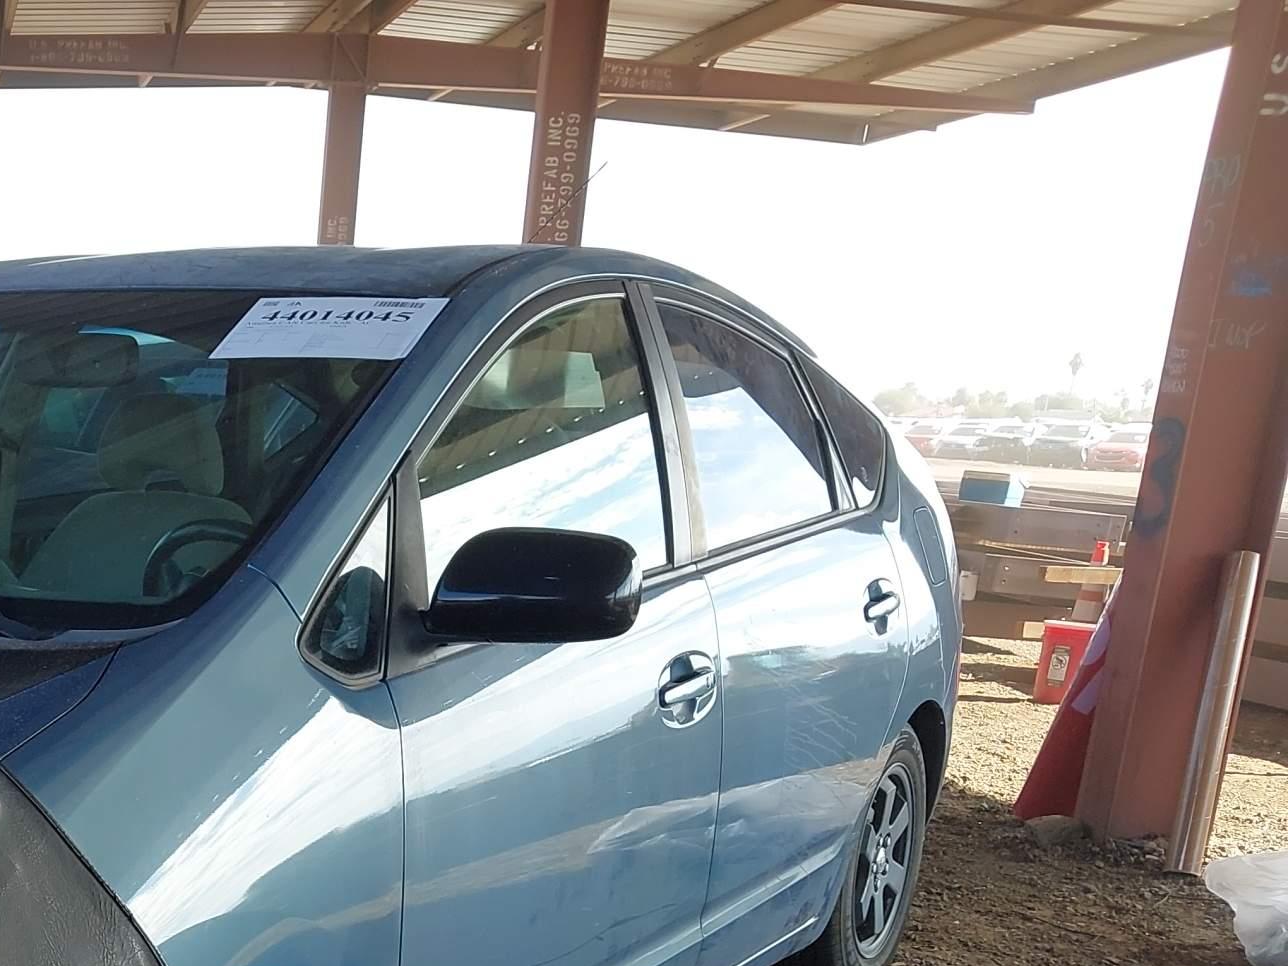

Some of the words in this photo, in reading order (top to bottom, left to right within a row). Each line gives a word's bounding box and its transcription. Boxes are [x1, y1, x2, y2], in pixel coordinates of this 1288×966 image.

[547, 111, 565, 146] INC.
[539, 156, 560, 226] PREFAB
[261, 309, 415, 323] 44014045
